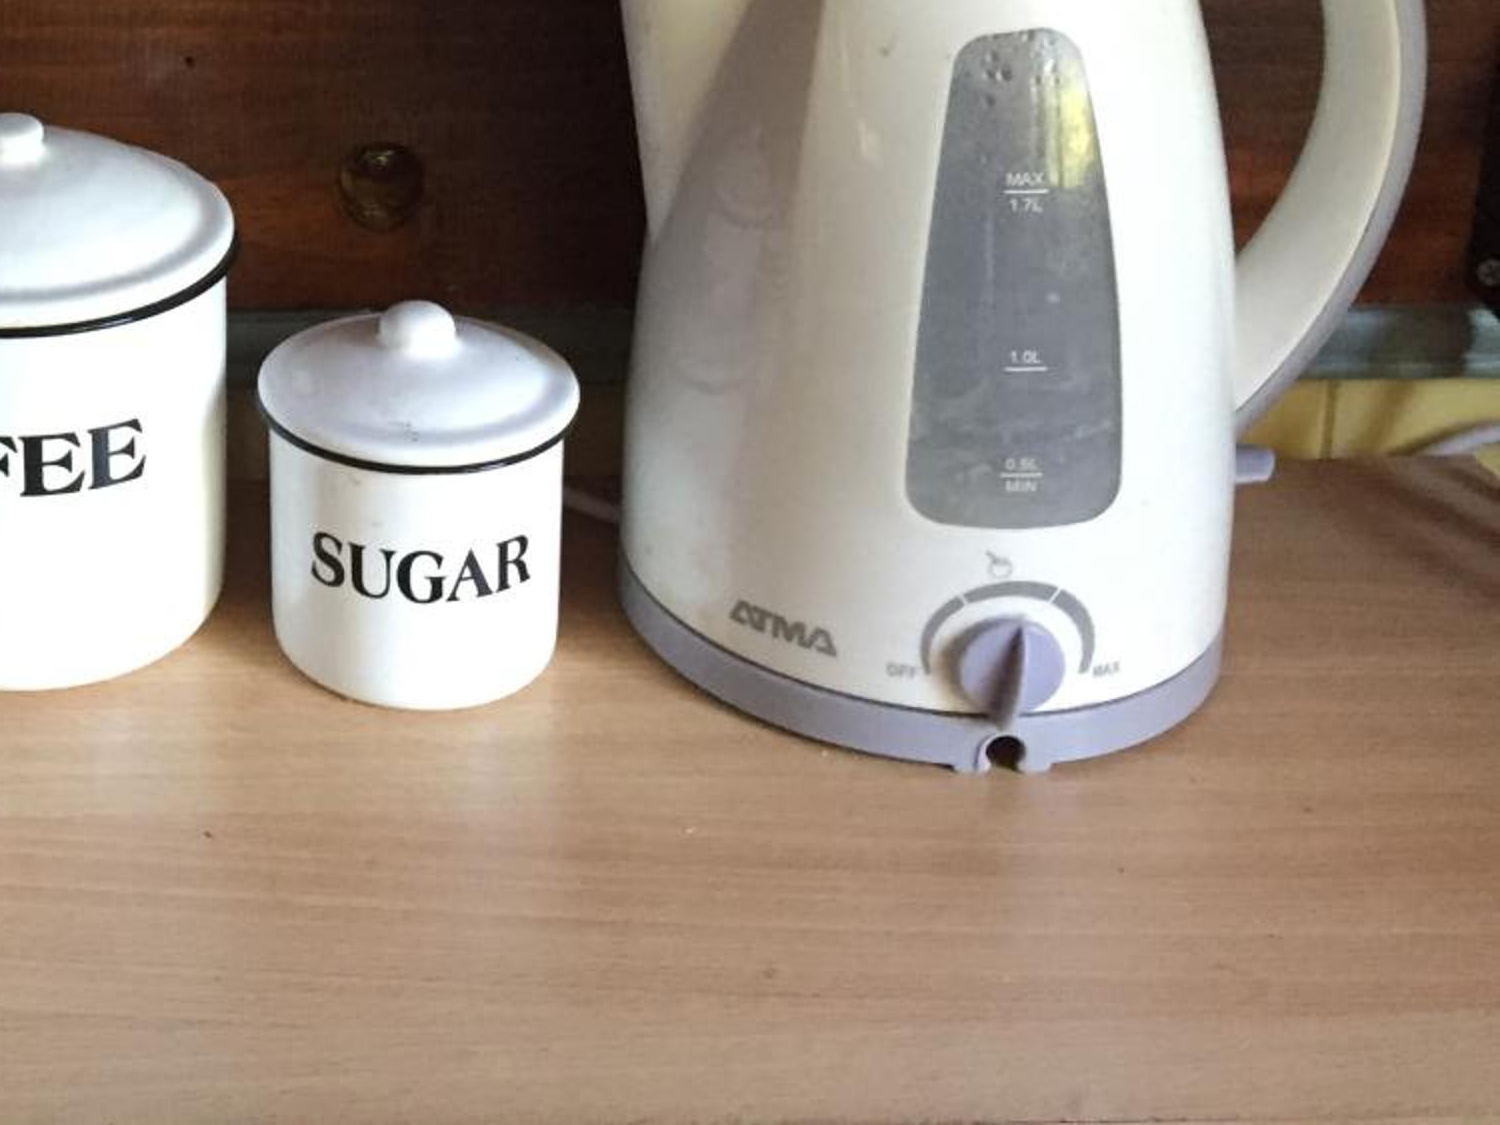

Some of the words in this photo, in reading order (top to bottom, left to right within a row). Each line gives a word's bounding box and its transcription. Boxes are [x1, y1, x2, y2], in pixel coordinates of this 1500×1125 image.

[1005, 172, 1045, 186] MAX
[1008, 198, 1044, 213] 1.7L
[1009, 350, 1041, 364] 1.0L
[1005, 480, 1037, 493] MIN
[311, 531, 531, 604] SUGAR
[729, 599, 838, 657] ATMA
